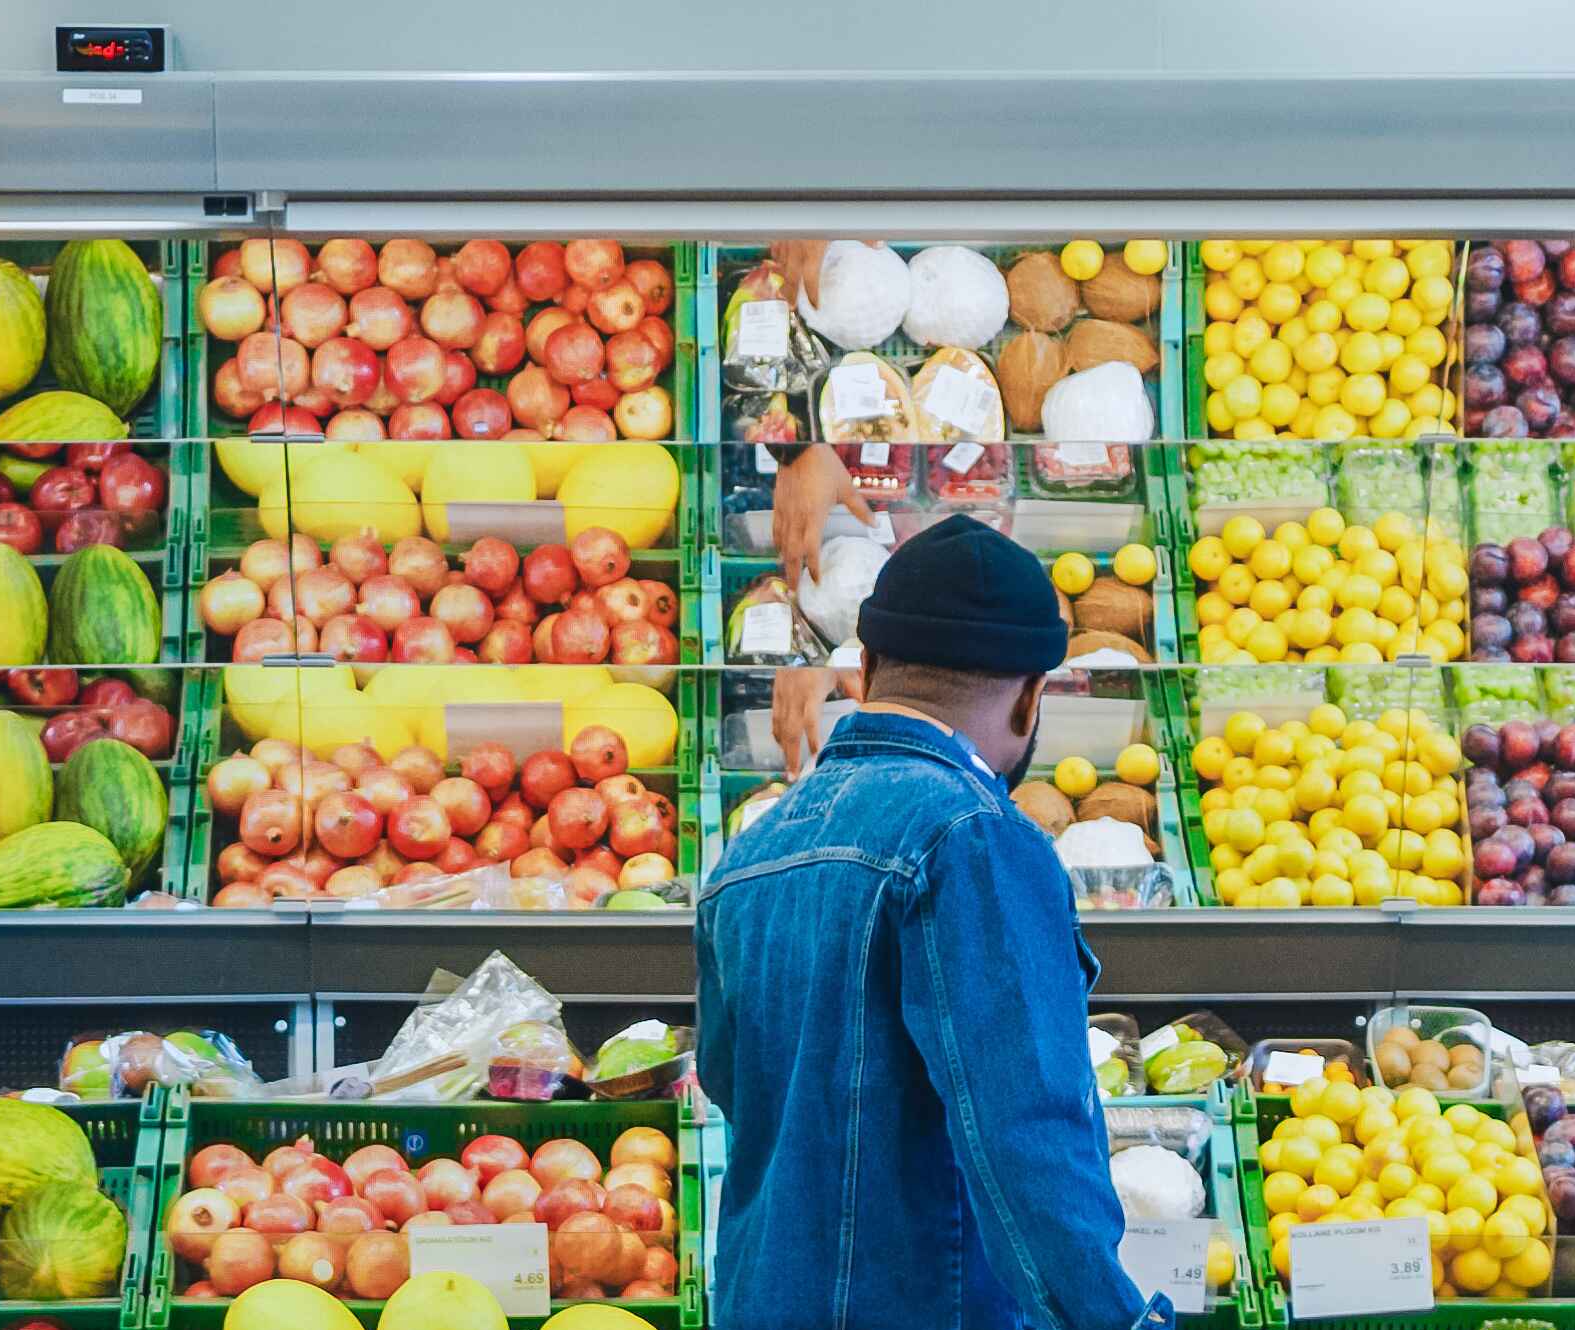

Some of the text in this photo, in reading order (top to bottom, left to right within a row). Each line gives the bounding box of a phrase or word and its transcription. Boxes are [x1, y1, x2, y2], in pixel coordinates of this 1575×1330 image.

[1172, 1266, 1203, 1280] 1.49
[1390, 1261, 1422, 1274] 3.89
[513, 1272, 545, 1285] 4.69
